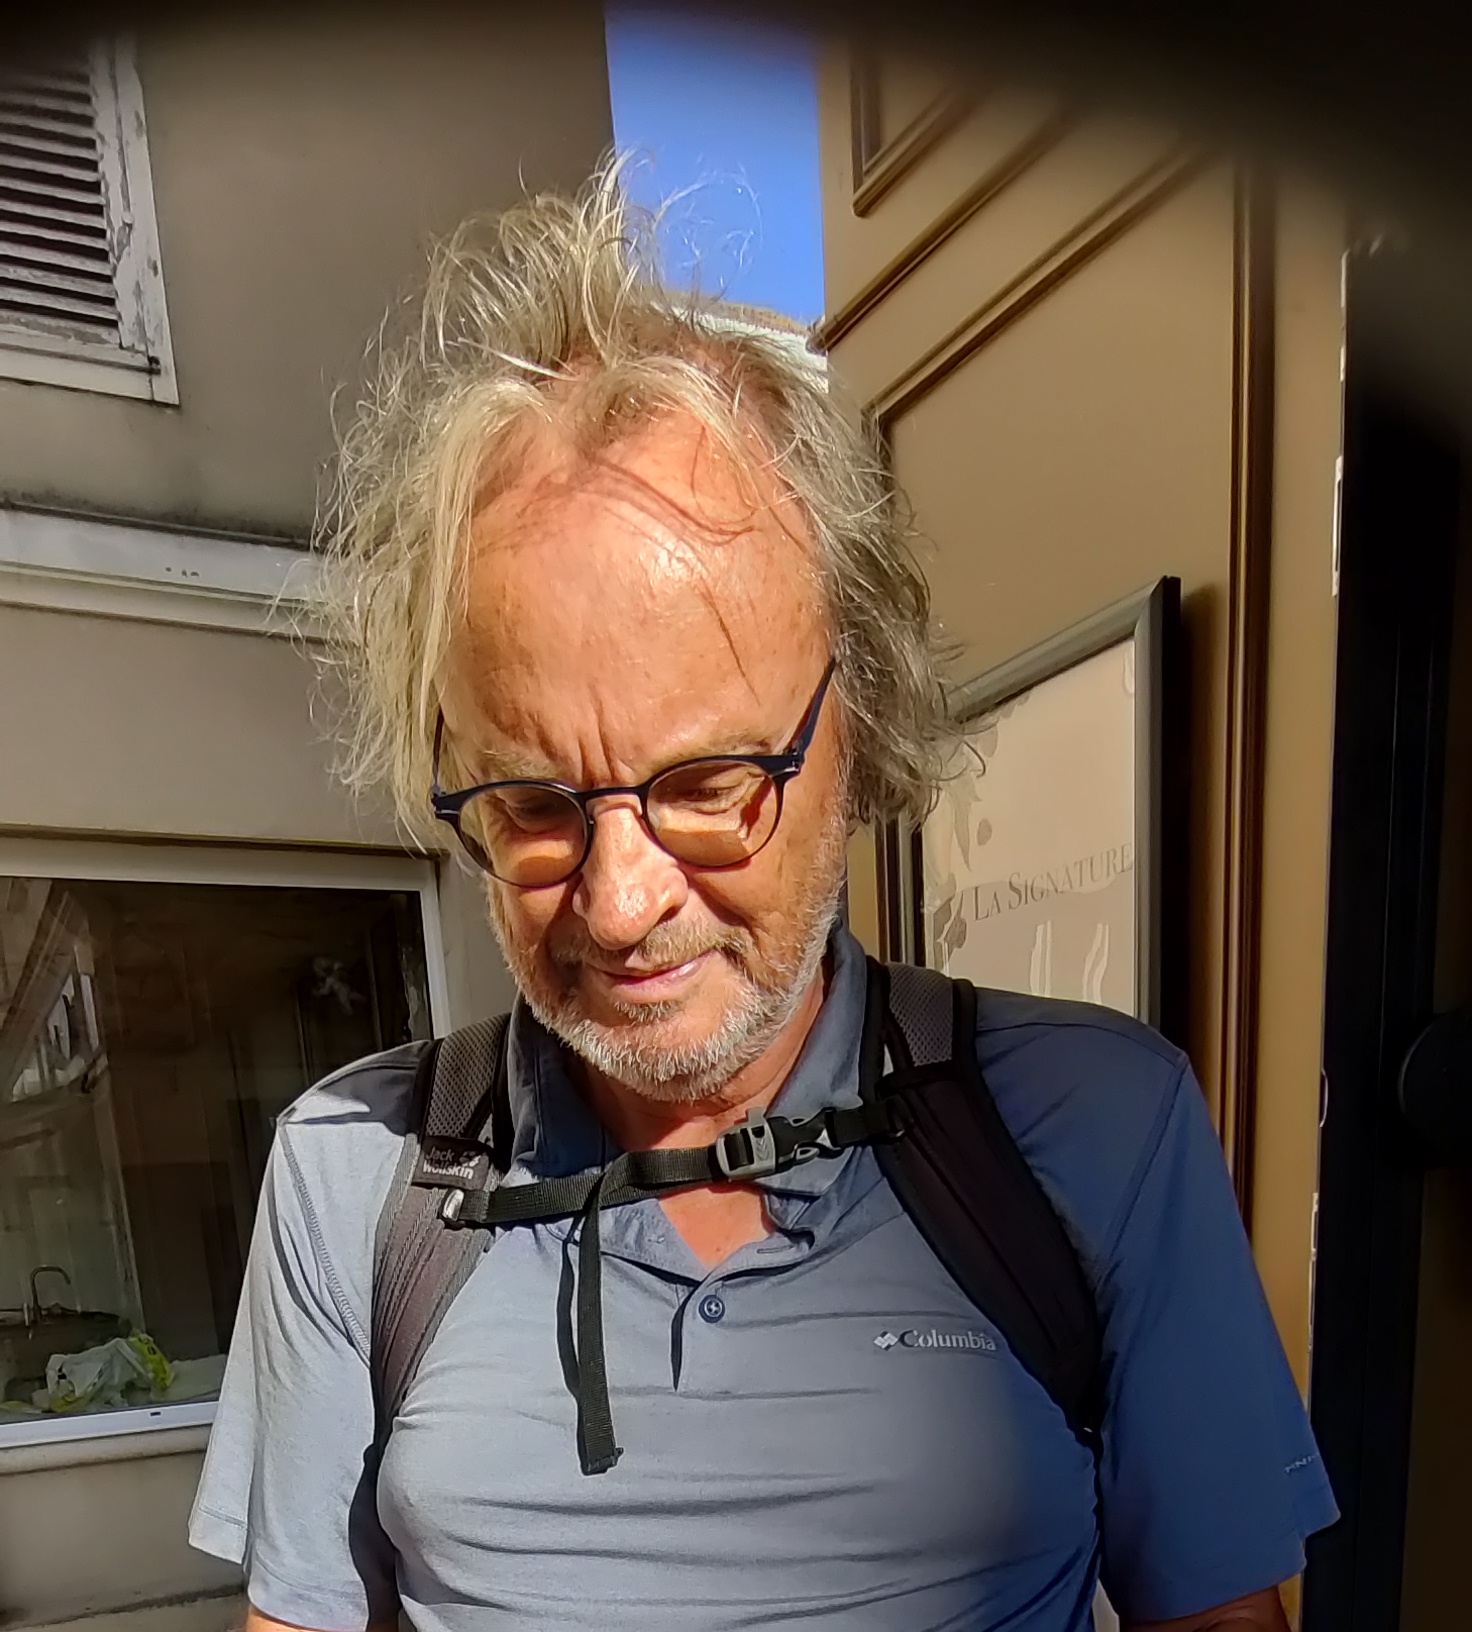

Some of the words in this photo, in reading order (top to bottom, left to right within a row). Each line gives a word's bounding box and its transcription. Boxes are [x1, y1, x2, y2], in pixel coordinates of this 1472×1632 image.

[424, 1146, 455, 1162] Jack
[422, 1159, 475, 1180] Wolfskin
[900, 1329, 997, 1351] Columbia
